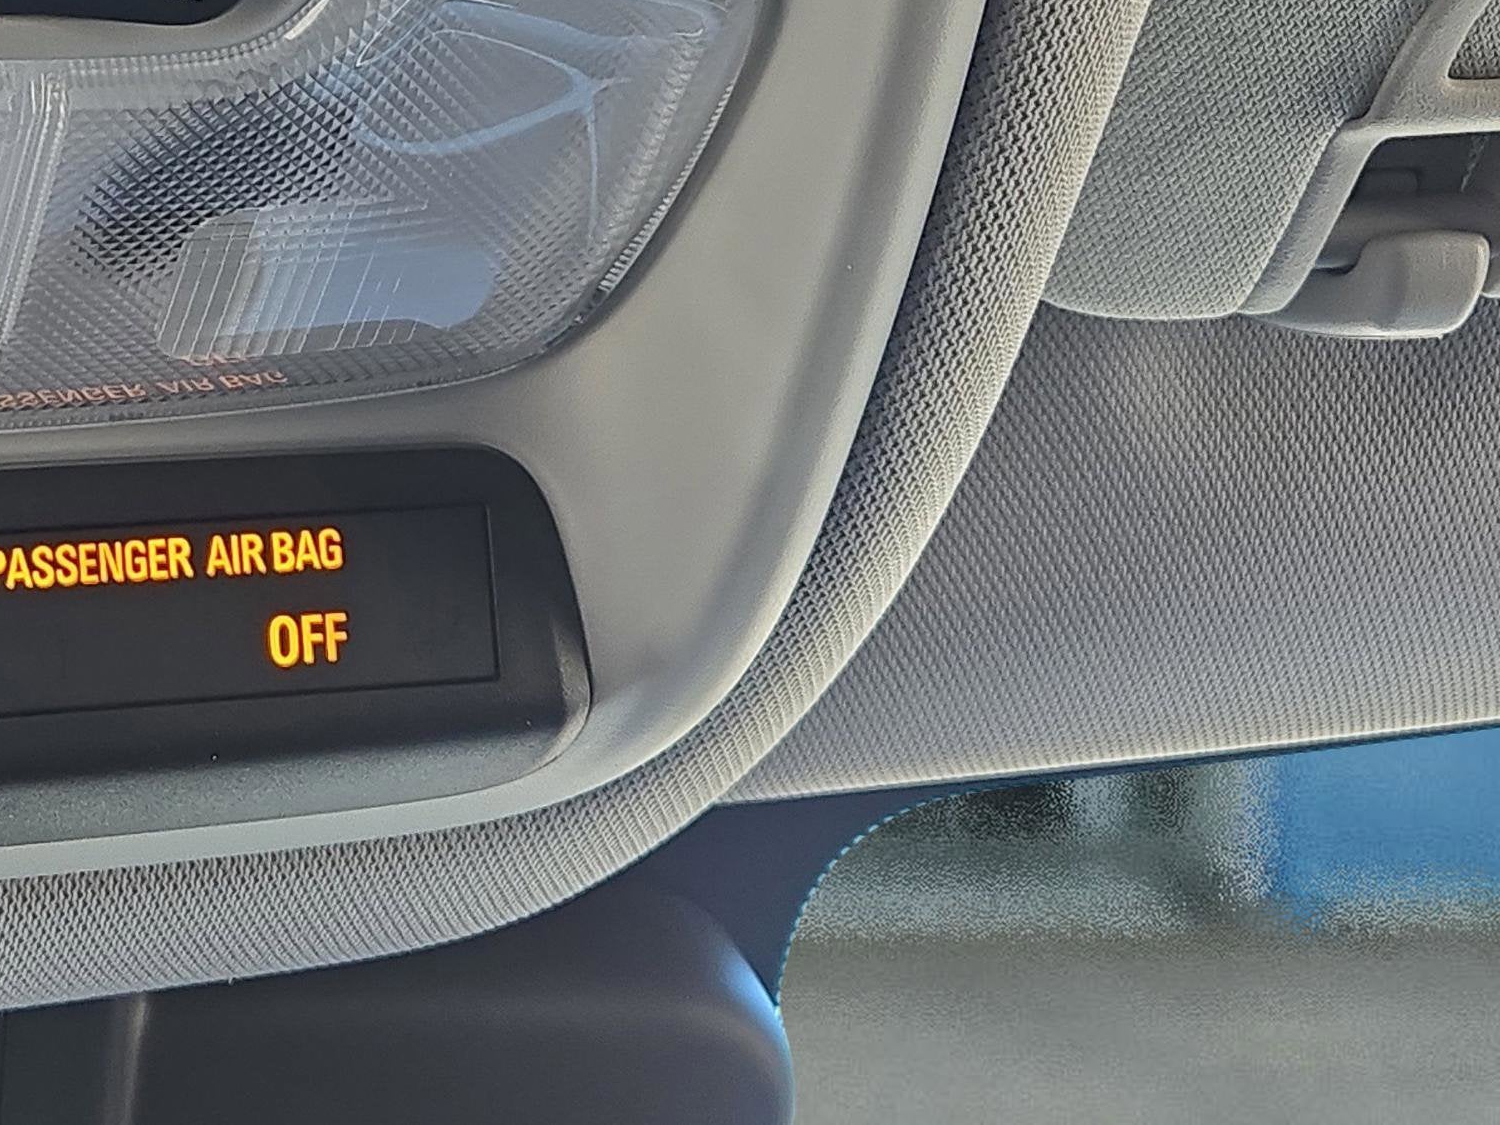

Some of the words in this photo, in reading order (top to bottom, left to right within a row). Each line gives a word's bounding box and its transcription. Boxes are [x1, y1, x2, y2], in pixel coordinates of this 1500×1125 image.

[207, 533, 267, 576] AIR
[271, 528, 343, 573] BAG
[268, 612, 348, 668] OFF
